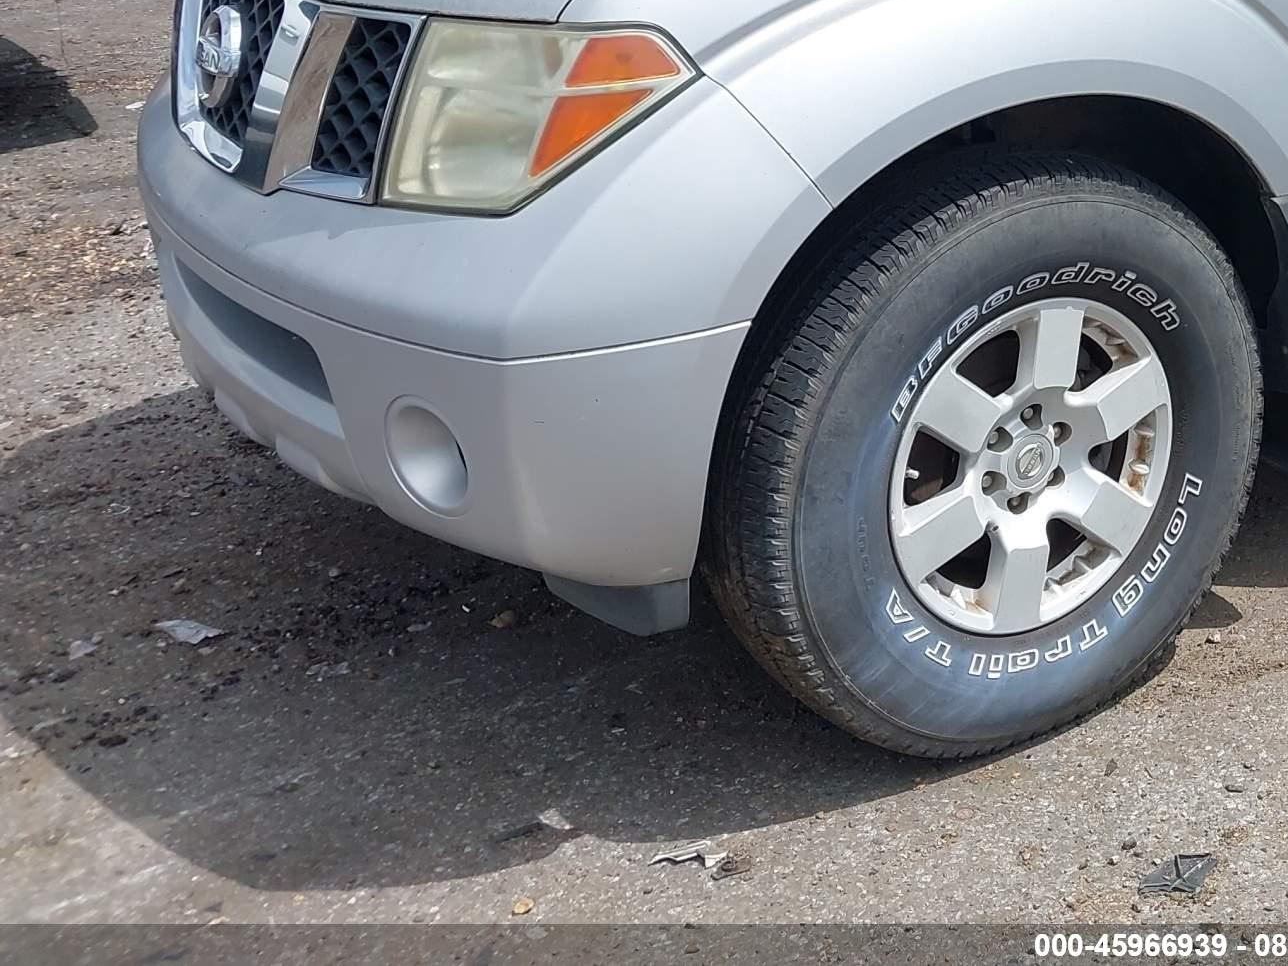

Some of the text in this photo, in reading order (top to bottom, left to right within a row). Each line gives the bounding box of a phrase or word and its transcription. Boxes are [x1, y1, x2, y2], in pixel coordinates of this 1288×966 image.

[890, 262, 1182, 423] BFGoodrich
[885, 472, 1203, 679] Long Trail T/A
